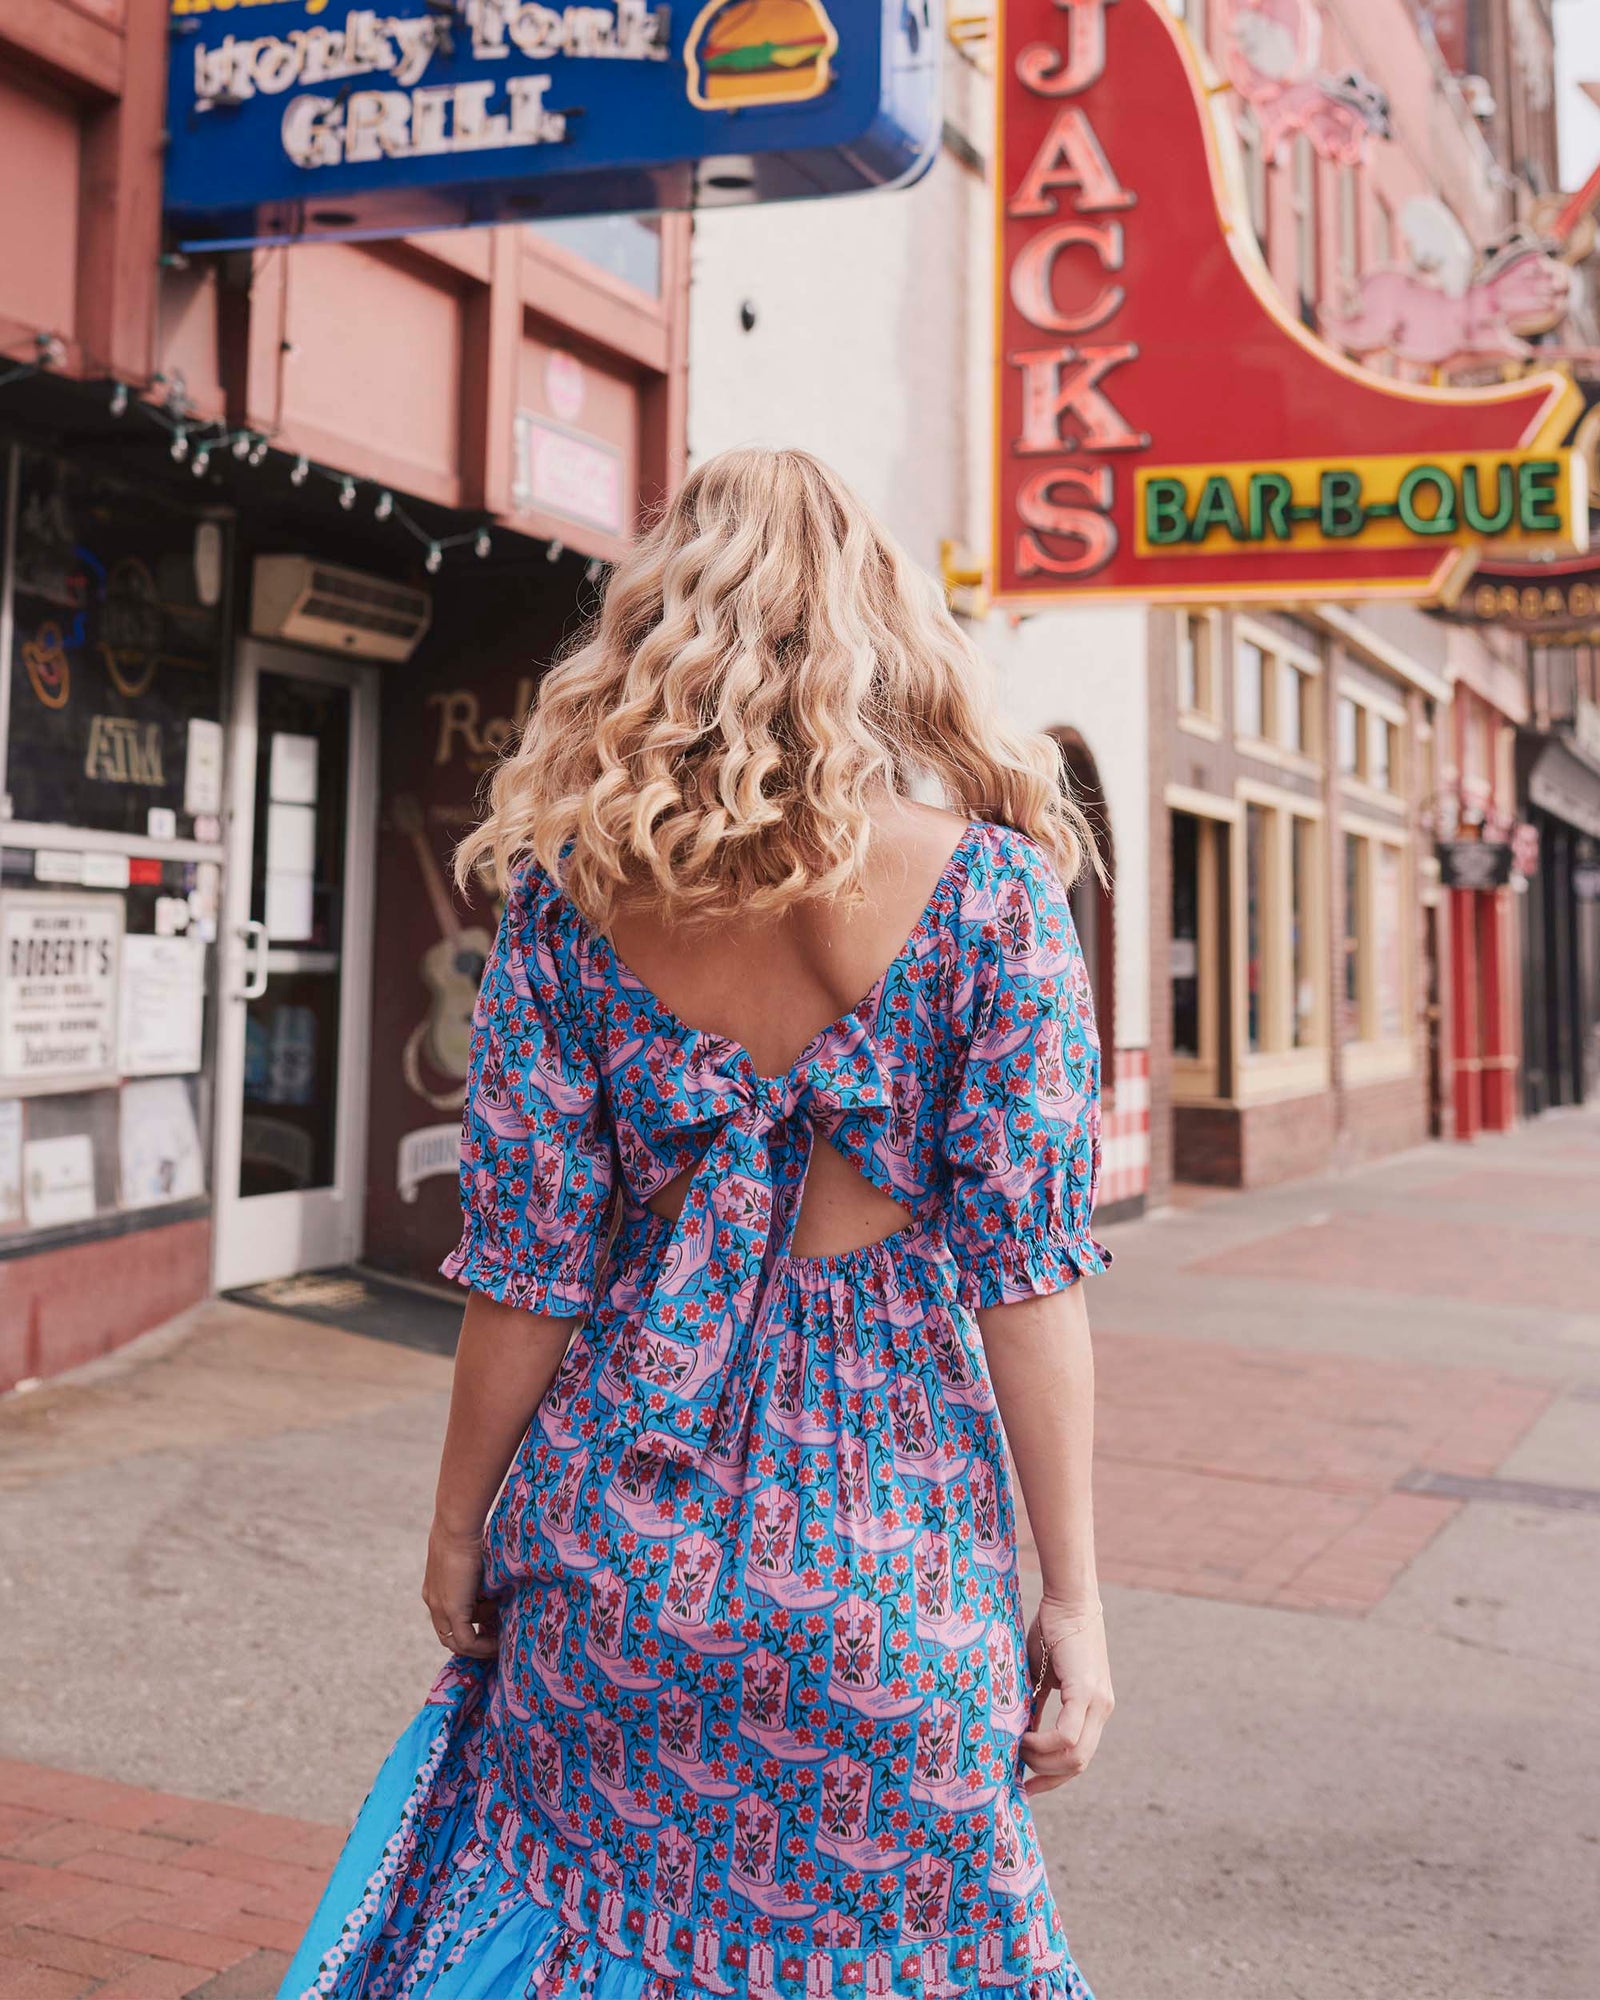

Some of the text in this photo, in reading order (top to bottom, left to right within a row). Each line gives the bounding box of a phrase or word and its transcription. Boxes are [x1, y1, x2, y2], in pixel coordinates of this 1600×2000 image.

[281, 74, 566, 168] GRILL
[1009, 0, 1151, 580] JACKS
[1144, 461, 1562, 545] BAR-B-QUE
[1474, 582, 1600, 622] BROAD
[84, 714, 166, 787] ATM
[10, 938, 110, 978] ROBERT'S
